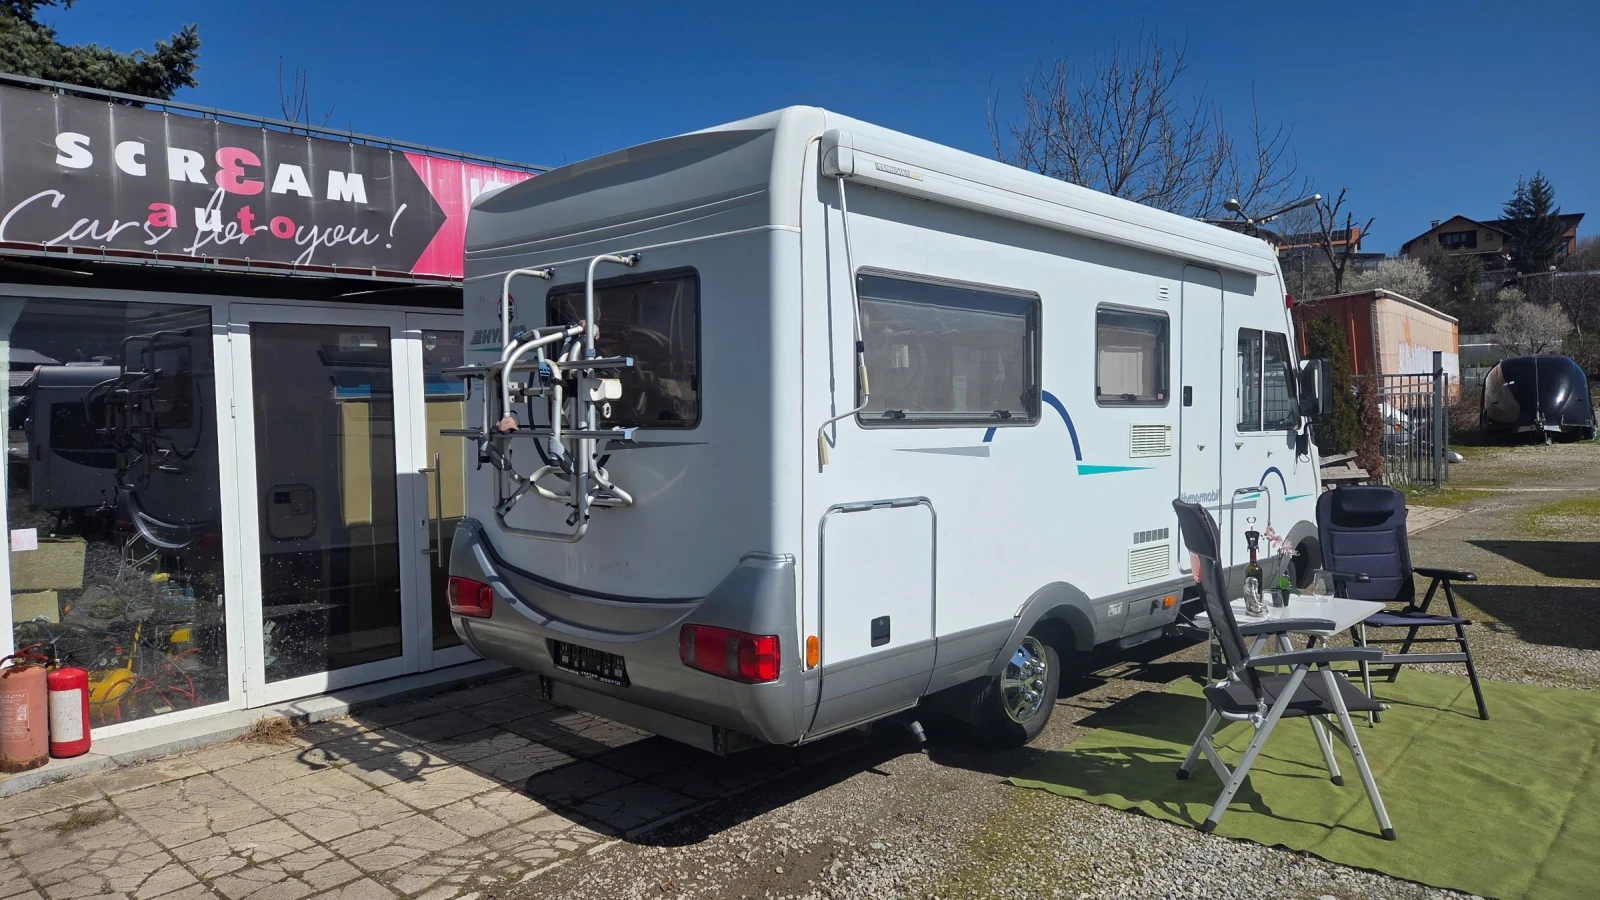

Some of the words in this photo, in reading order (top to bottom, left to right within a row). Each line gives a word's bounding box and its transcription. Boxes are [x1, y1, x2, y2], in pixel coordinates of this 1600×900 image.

[55, 132, 368, 204] SCREAM
[0, 189, 173, 246] Cars
[294, 203, 408, 266] you!
[147, 203, 296, 239] auto
